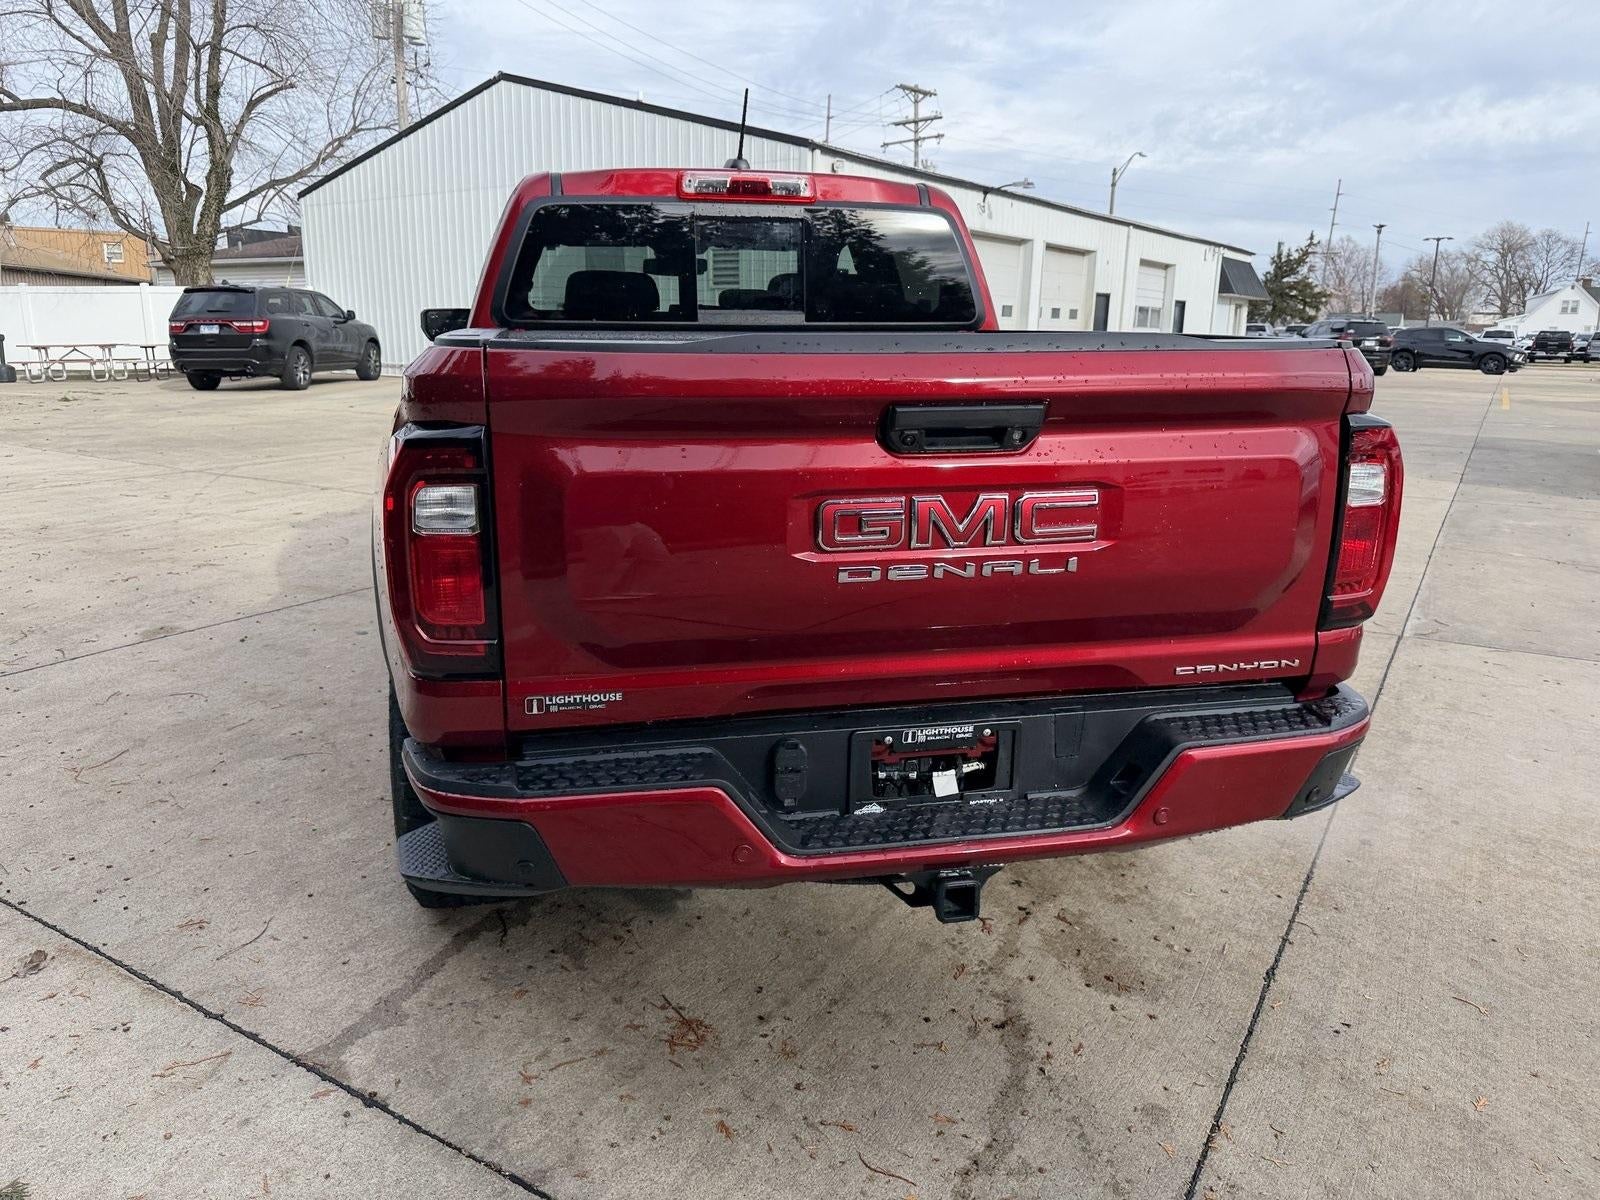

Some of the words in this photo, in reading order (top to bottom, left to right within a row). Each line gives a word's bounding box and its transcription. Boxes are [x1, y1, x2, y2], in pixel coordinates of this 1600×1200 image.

[816, 488, 1099, 551] GMC
[837, 556, 1078, 584] DENALI
[1175, 659, 1300, 675] CANYON
[545, 692, 623, 705] LIGHTHOUSE
[917, 725, 975, 736] LIGHTHOUSE
